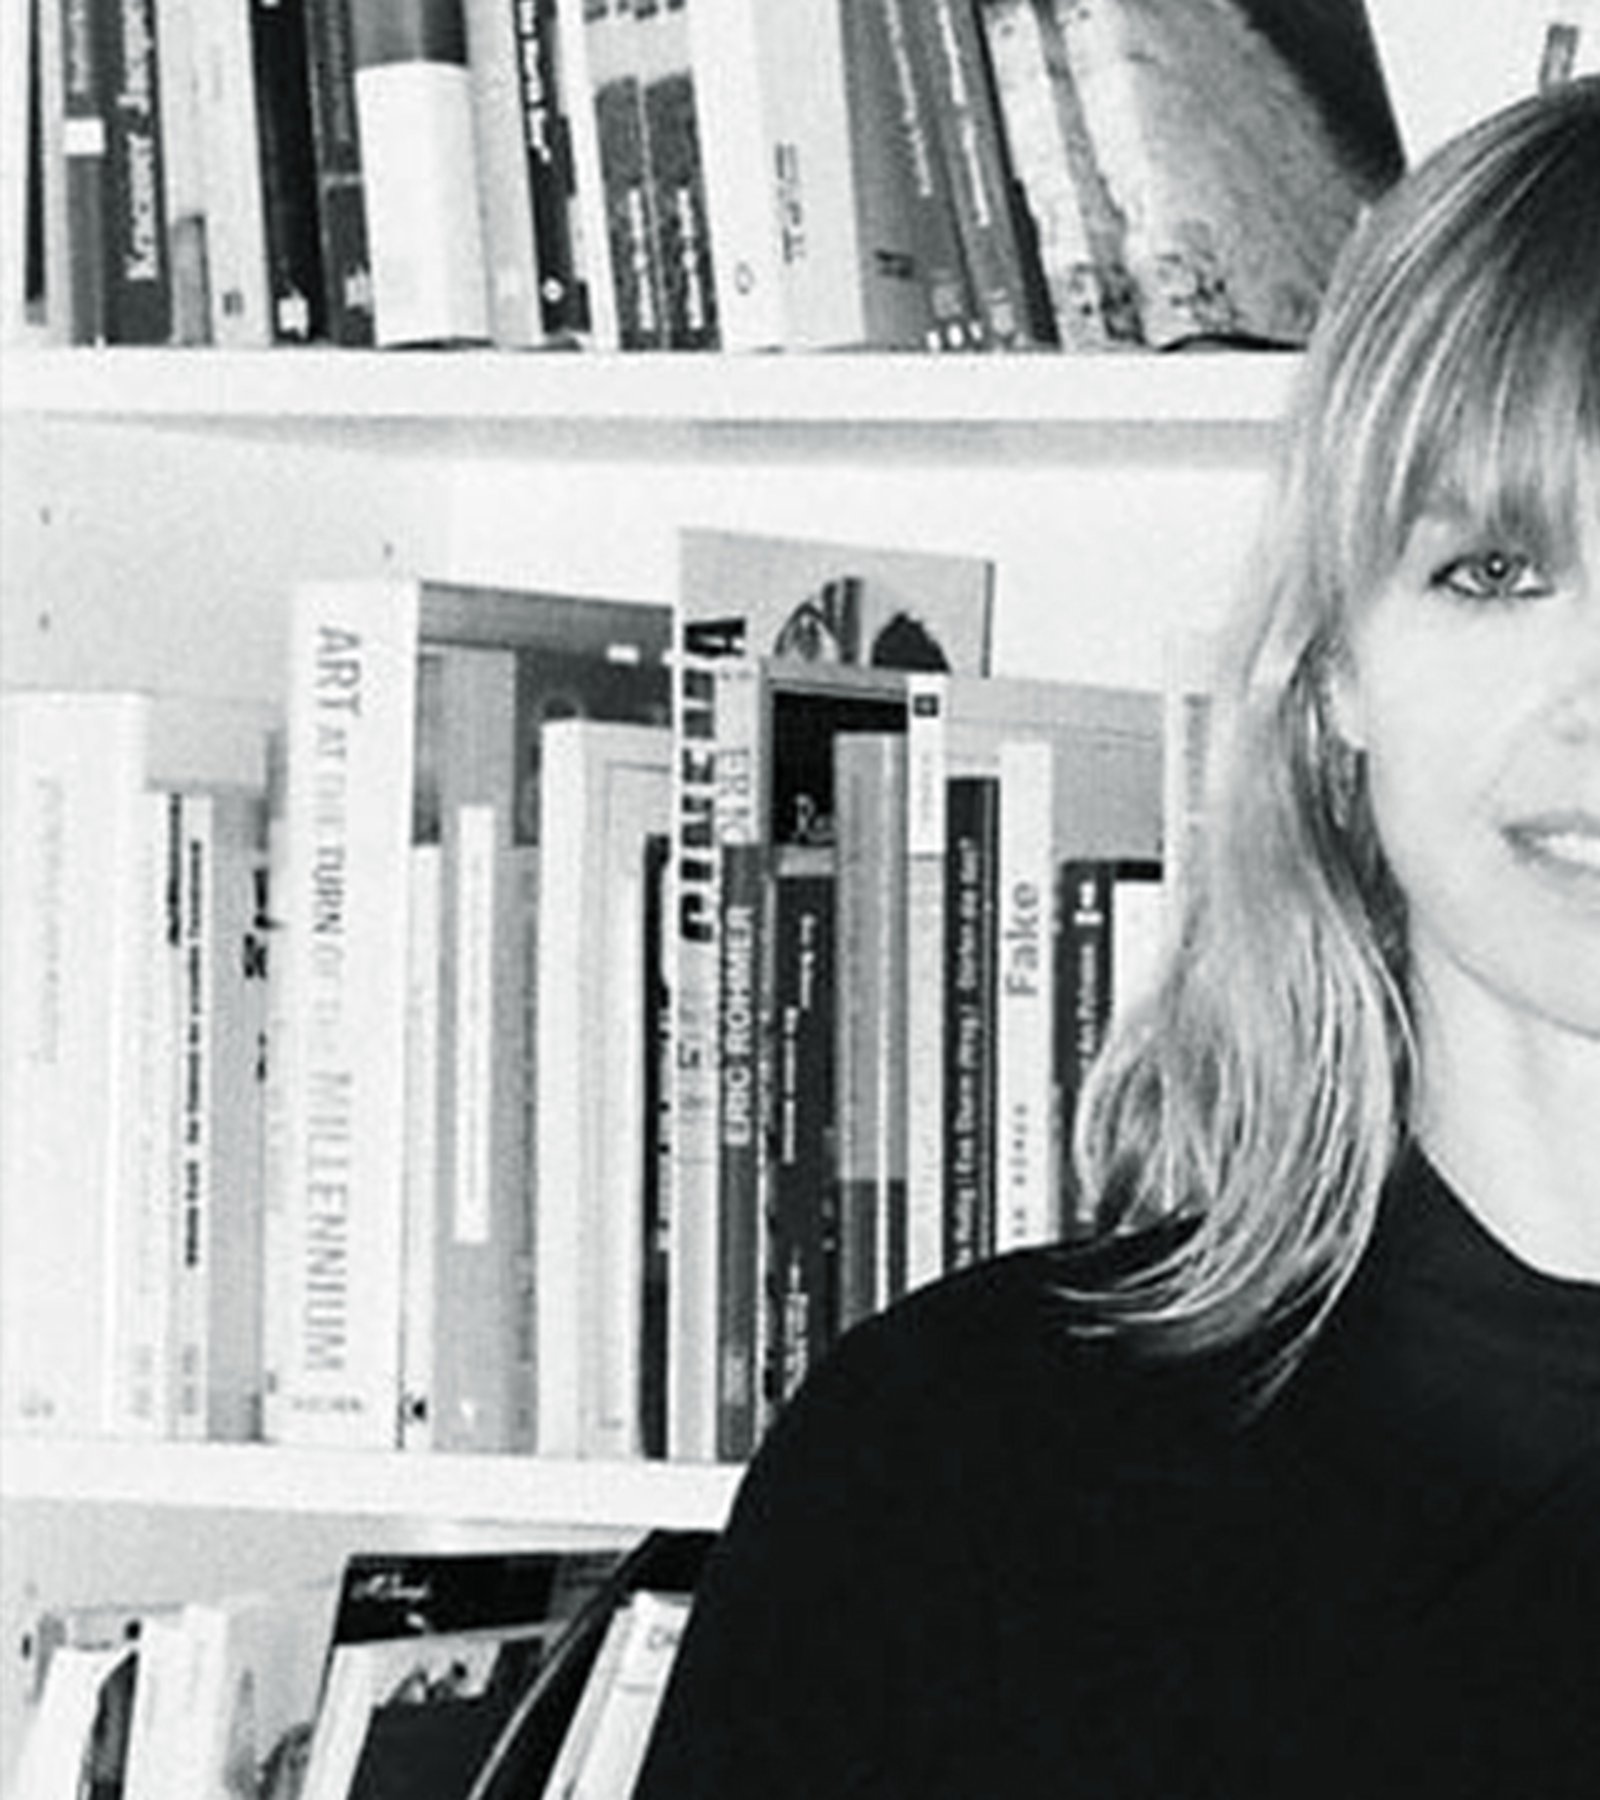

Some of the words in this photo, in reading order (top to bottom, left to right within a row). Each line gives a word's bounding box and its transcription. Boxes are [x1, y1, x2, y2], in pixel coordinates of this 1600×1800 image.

[317, 626, 363, 717] ART
[316, 724, 347, 761] AT
[312, 847, 346, 936] TURN
[725, 906, 755, 1056] ROHMER
[1003, 881, 1043, 998] Fake
[725, 1066, 754, 1147] ERIC
[306, 1071, 353, 1370] MILLENNIUM
